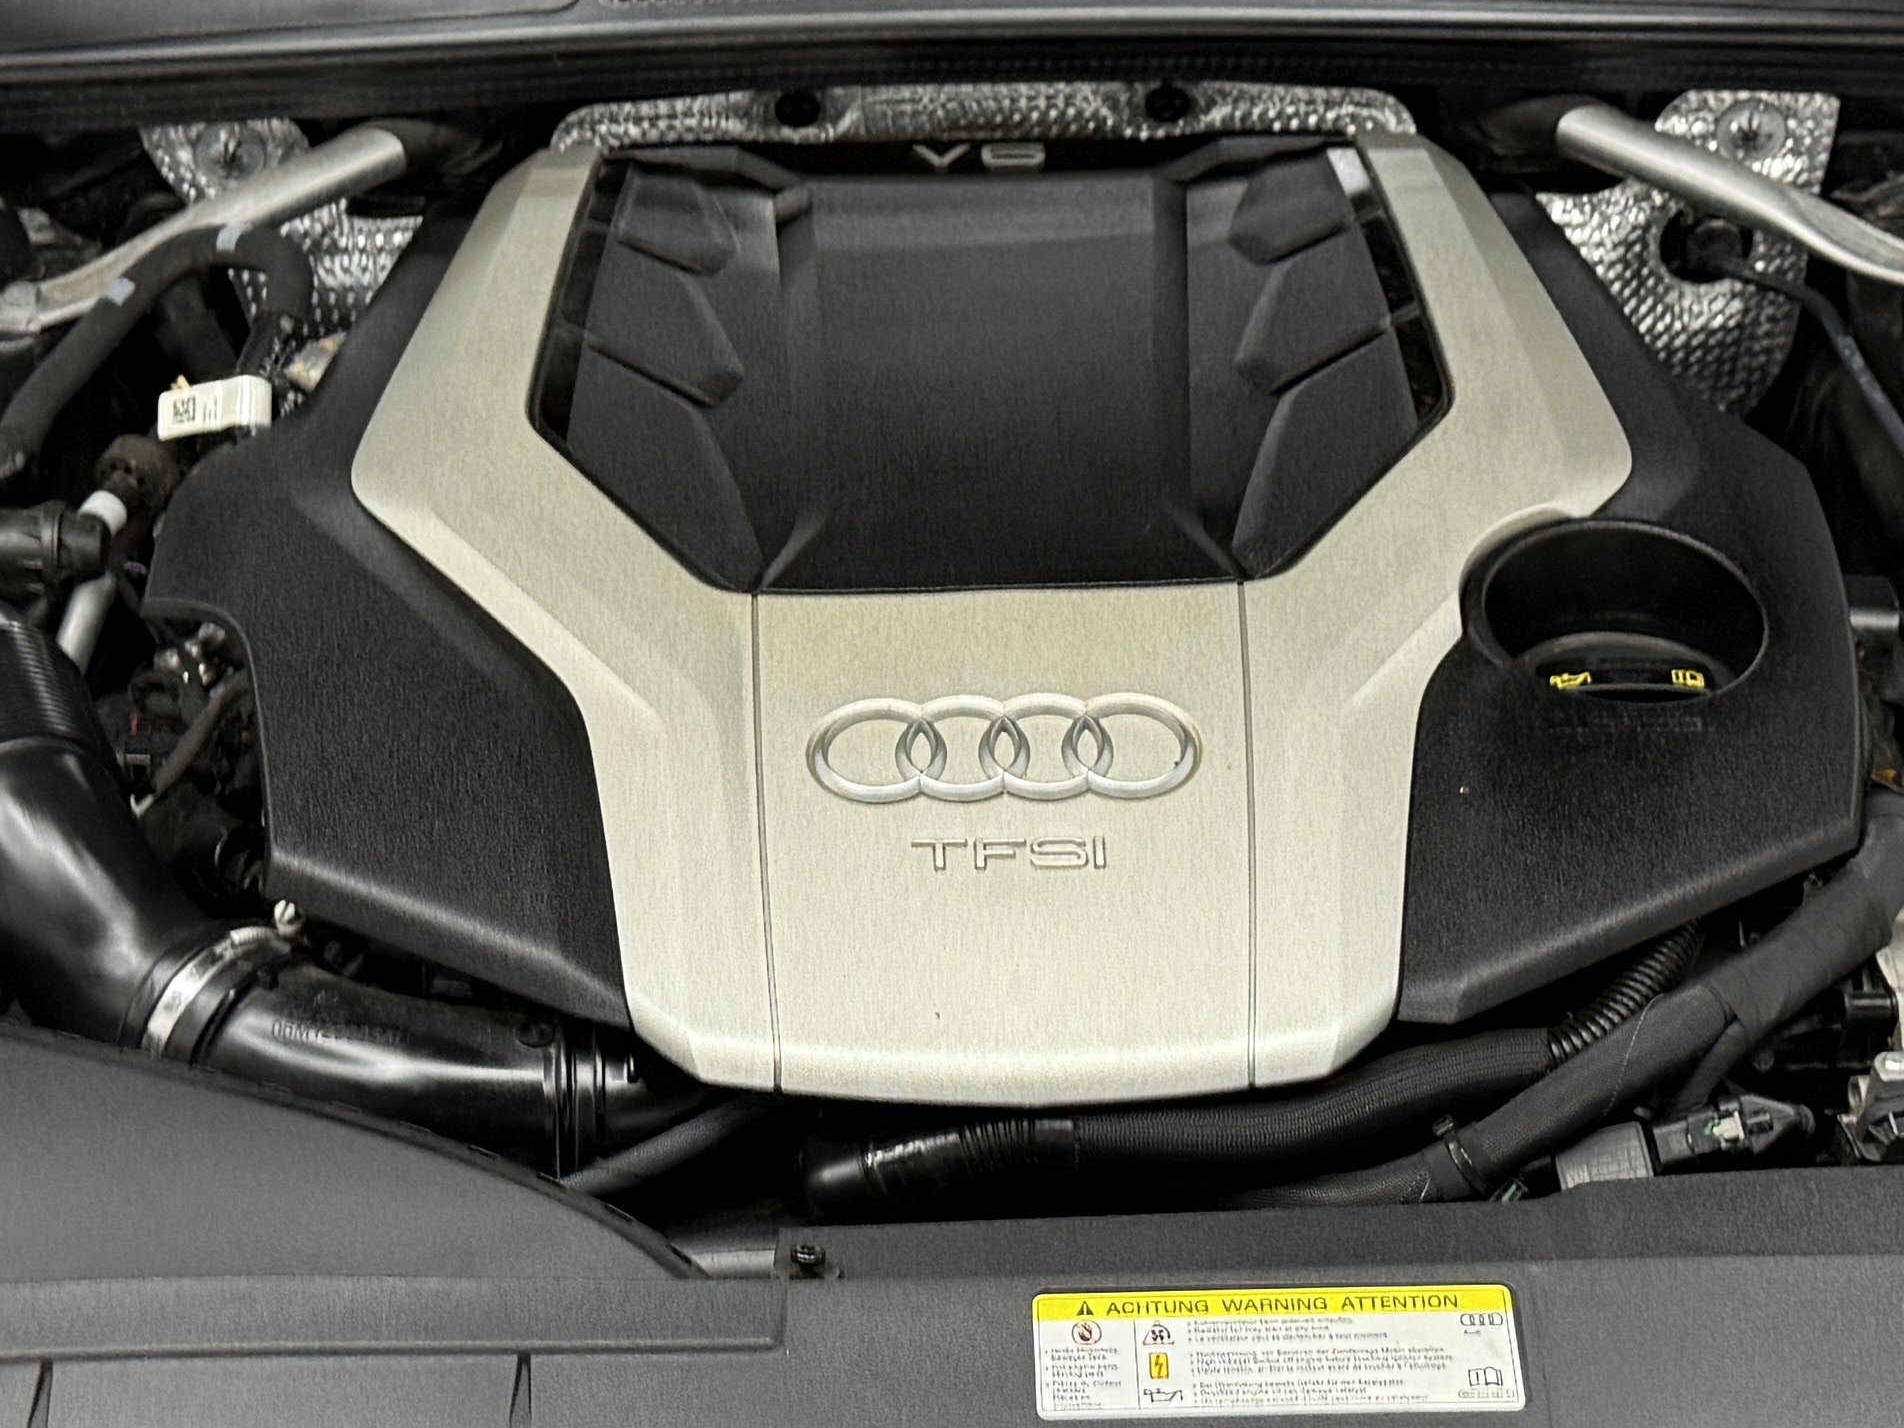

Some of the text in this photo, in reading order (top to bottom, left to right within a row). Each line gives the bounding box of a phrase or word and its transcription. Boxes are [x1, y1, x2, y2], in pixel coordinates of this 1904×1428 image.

[910, 835, 1107, 871] TFSI
[1106, 1294, 1458, 1316] ACHTUNG WARNING ATTENTION
